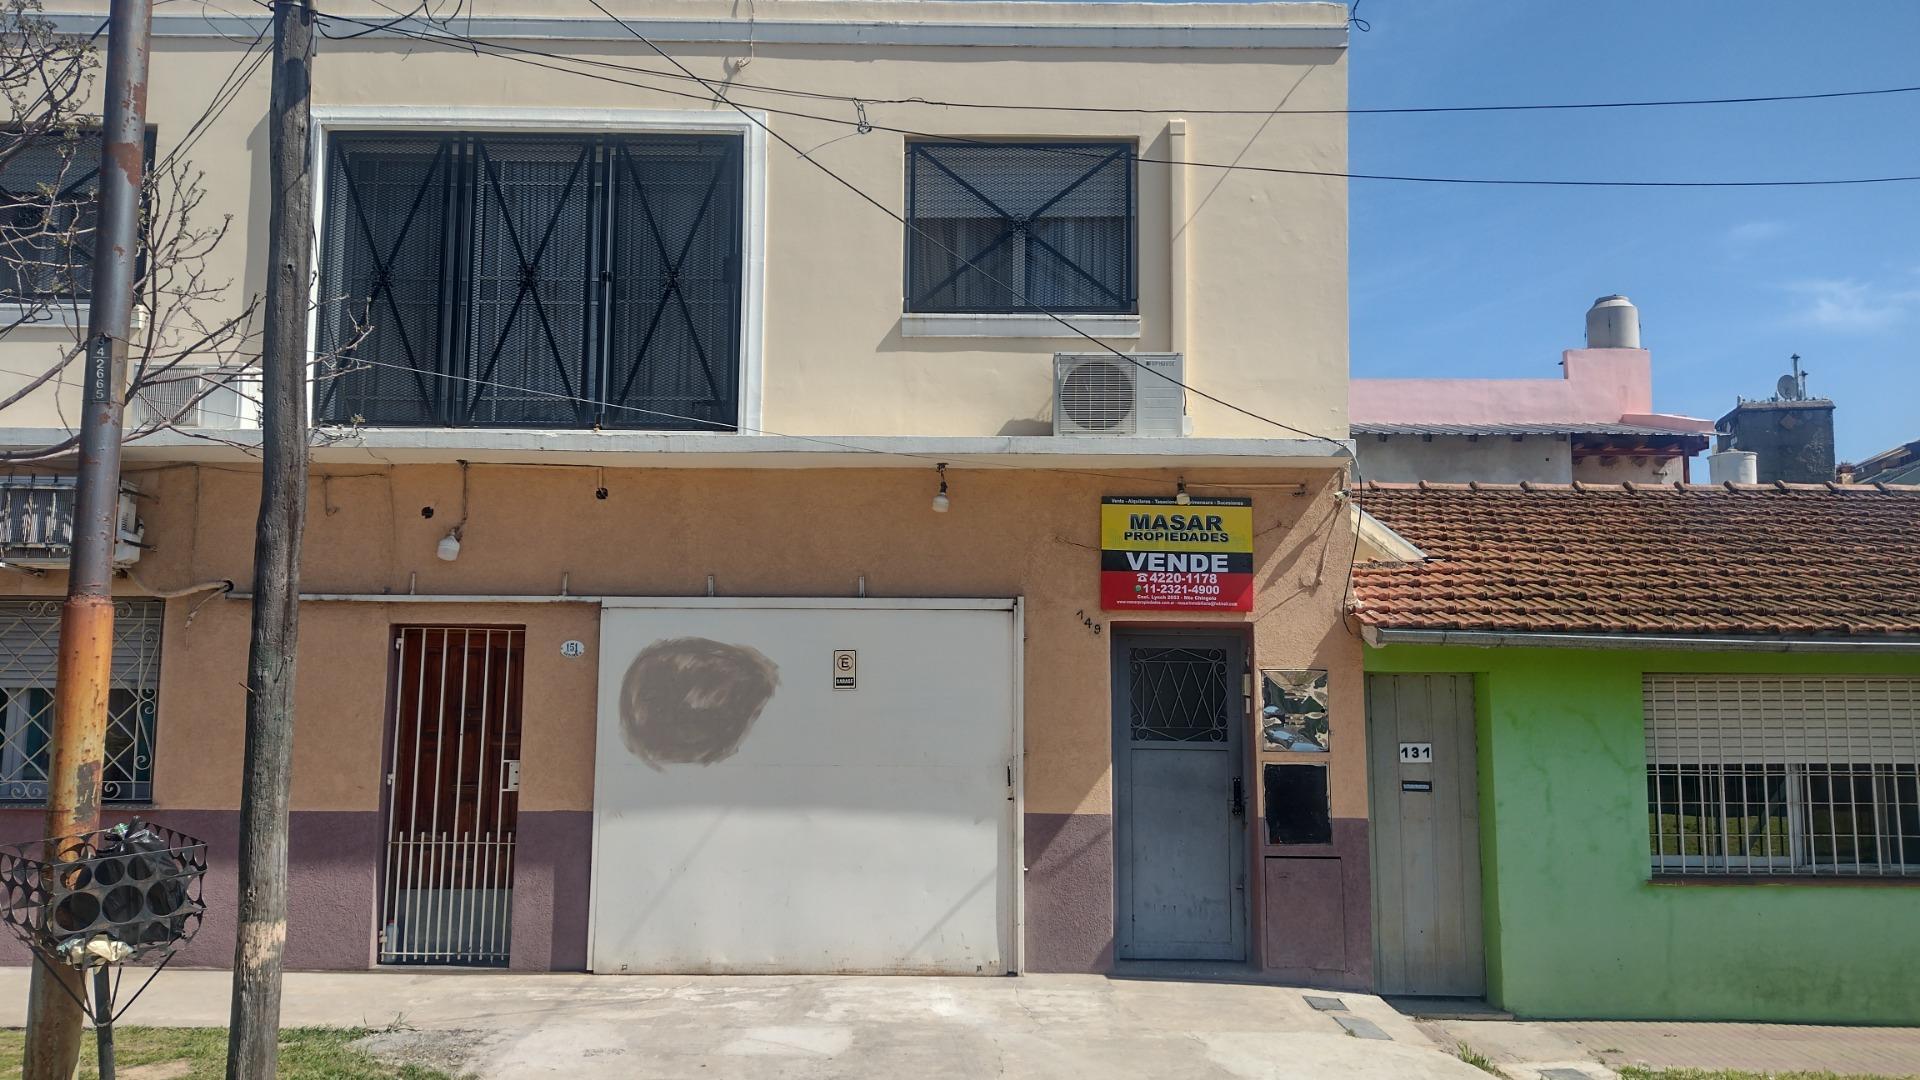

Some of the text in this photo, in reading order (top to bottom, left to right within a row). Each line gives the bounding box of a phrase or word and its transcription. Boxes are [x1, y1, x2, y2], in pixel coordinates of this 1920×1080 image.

[1130, 513, 1223, 532] MASAR
[1124, 531, 1229, 543] PROPIEDADES
[1126, 551, 1229, 573] VENDE
[1149, 573, 1217, 584] 4220-1178
[1143, 583, 1220, 595] 11-2321-4900
[1076, 609, 1101, 635] 149
[841, 657, 849, 668] E
[1400, 746, 1430, 759] 131
